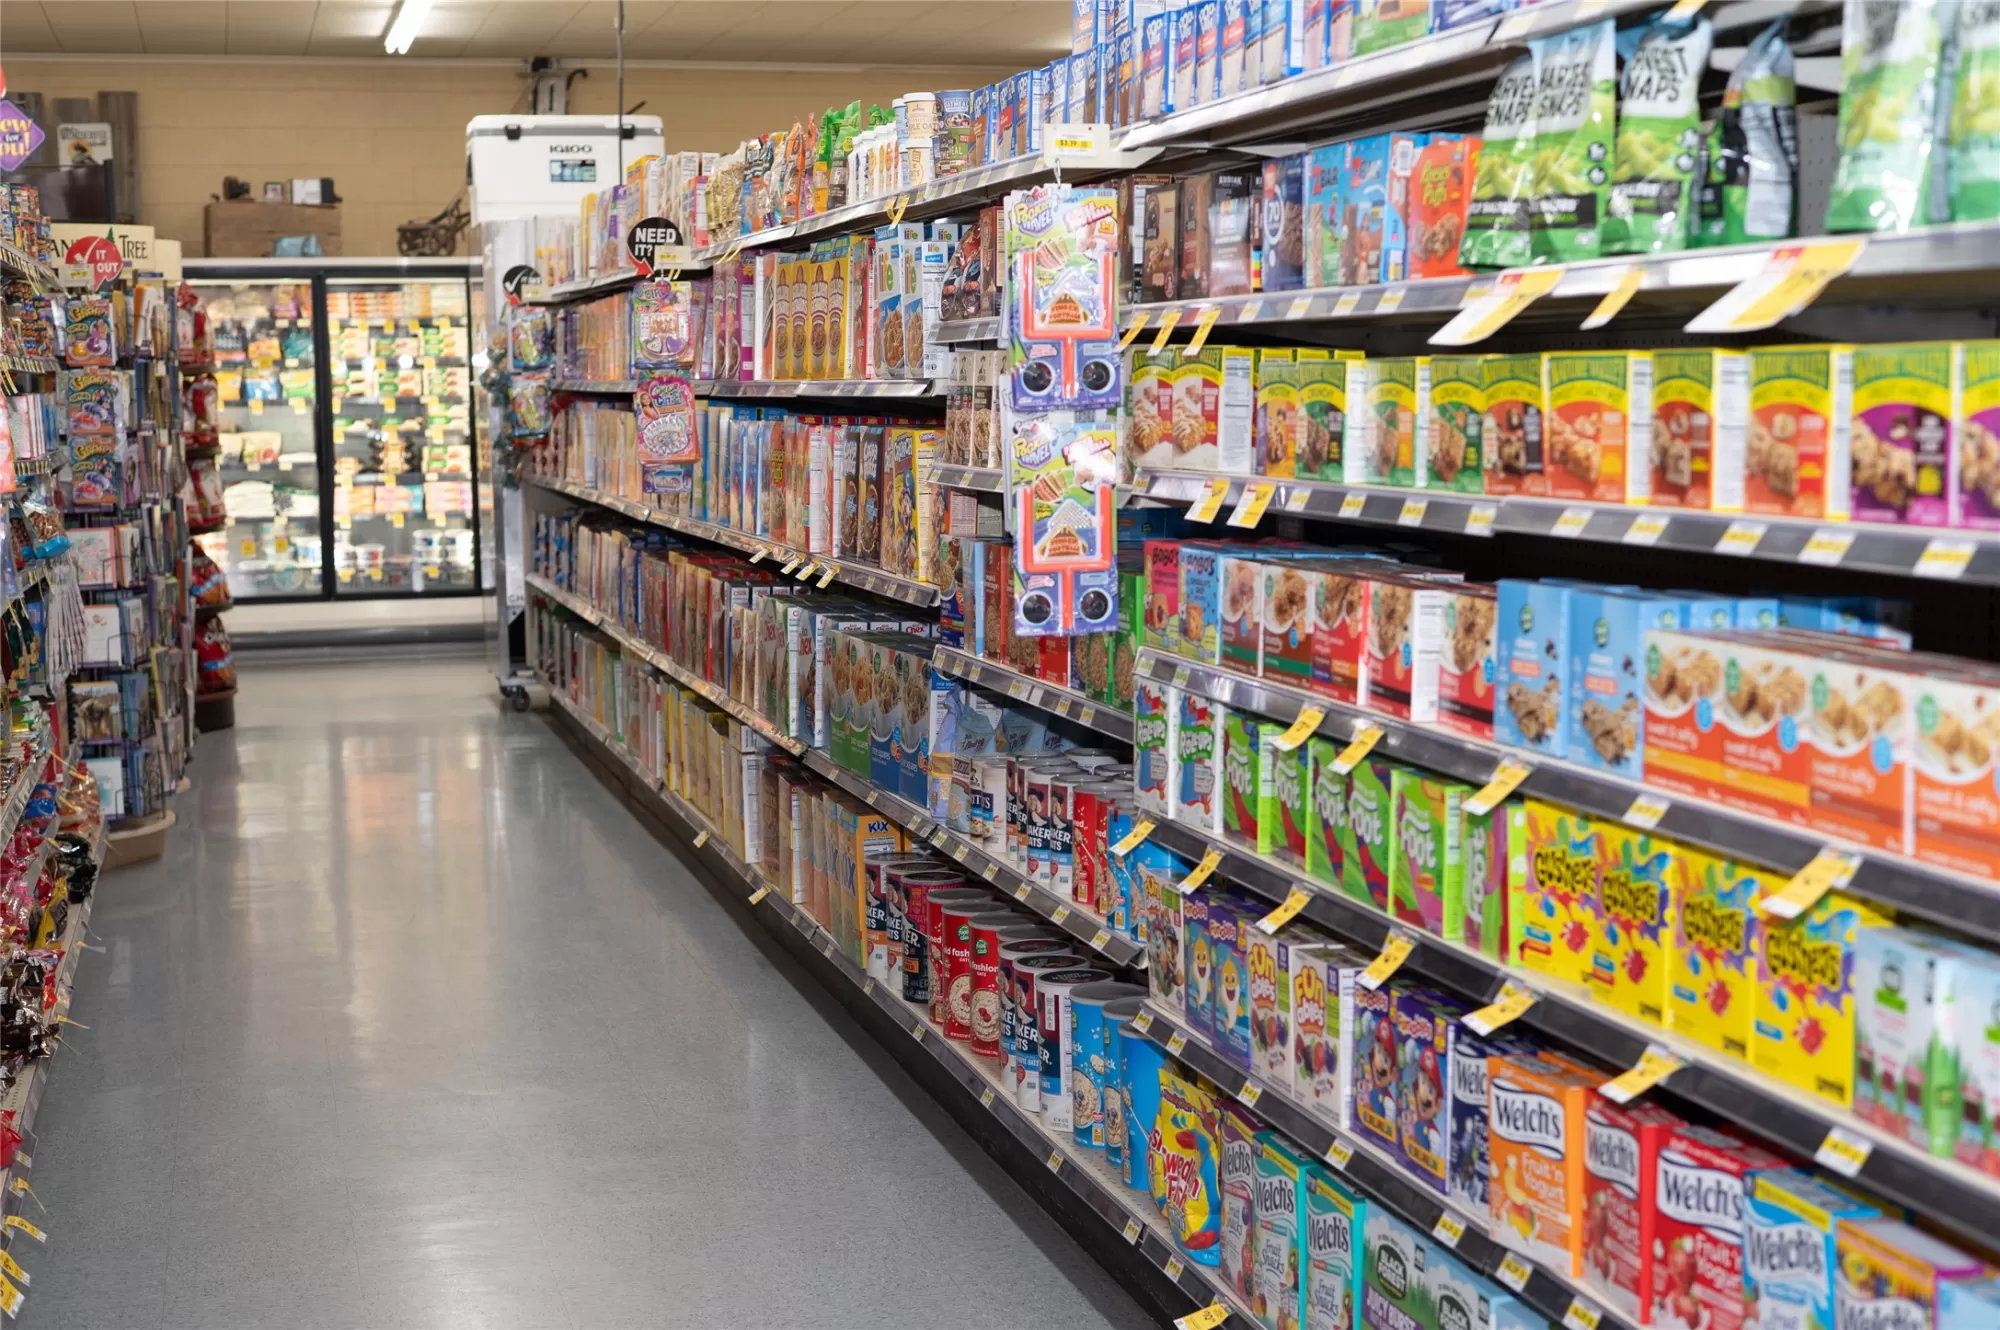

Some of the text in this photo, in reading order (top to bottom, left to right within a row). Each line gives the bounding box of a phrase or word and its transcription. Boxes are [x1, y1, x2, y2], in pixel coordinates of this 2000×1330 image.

[1218, 175, 1242, 186] KODIAK
[1268, 202, 1281, 223] 70
[635, 227, 677, 243] NEED
[904, 227, 919, 240] life
[938, 228, 953, 241] life
[118, 234, 149, 259] TREE
[634, 244, 653, 257] IT?
[96, 249, 107, 261] IT
[97, 262, 119, 273] OUT
[868, 821, 889, 833] KIX
[1494, 1092, 1561, 1140] Welch's
[1587, 1125, 1636, 1179] Welch's
[1255, 1176, 1294, 1215] Welch's
[1661, 1166, 1743, 1222] Welch's
[1308, 1213, 1349, 1253] Welch's
